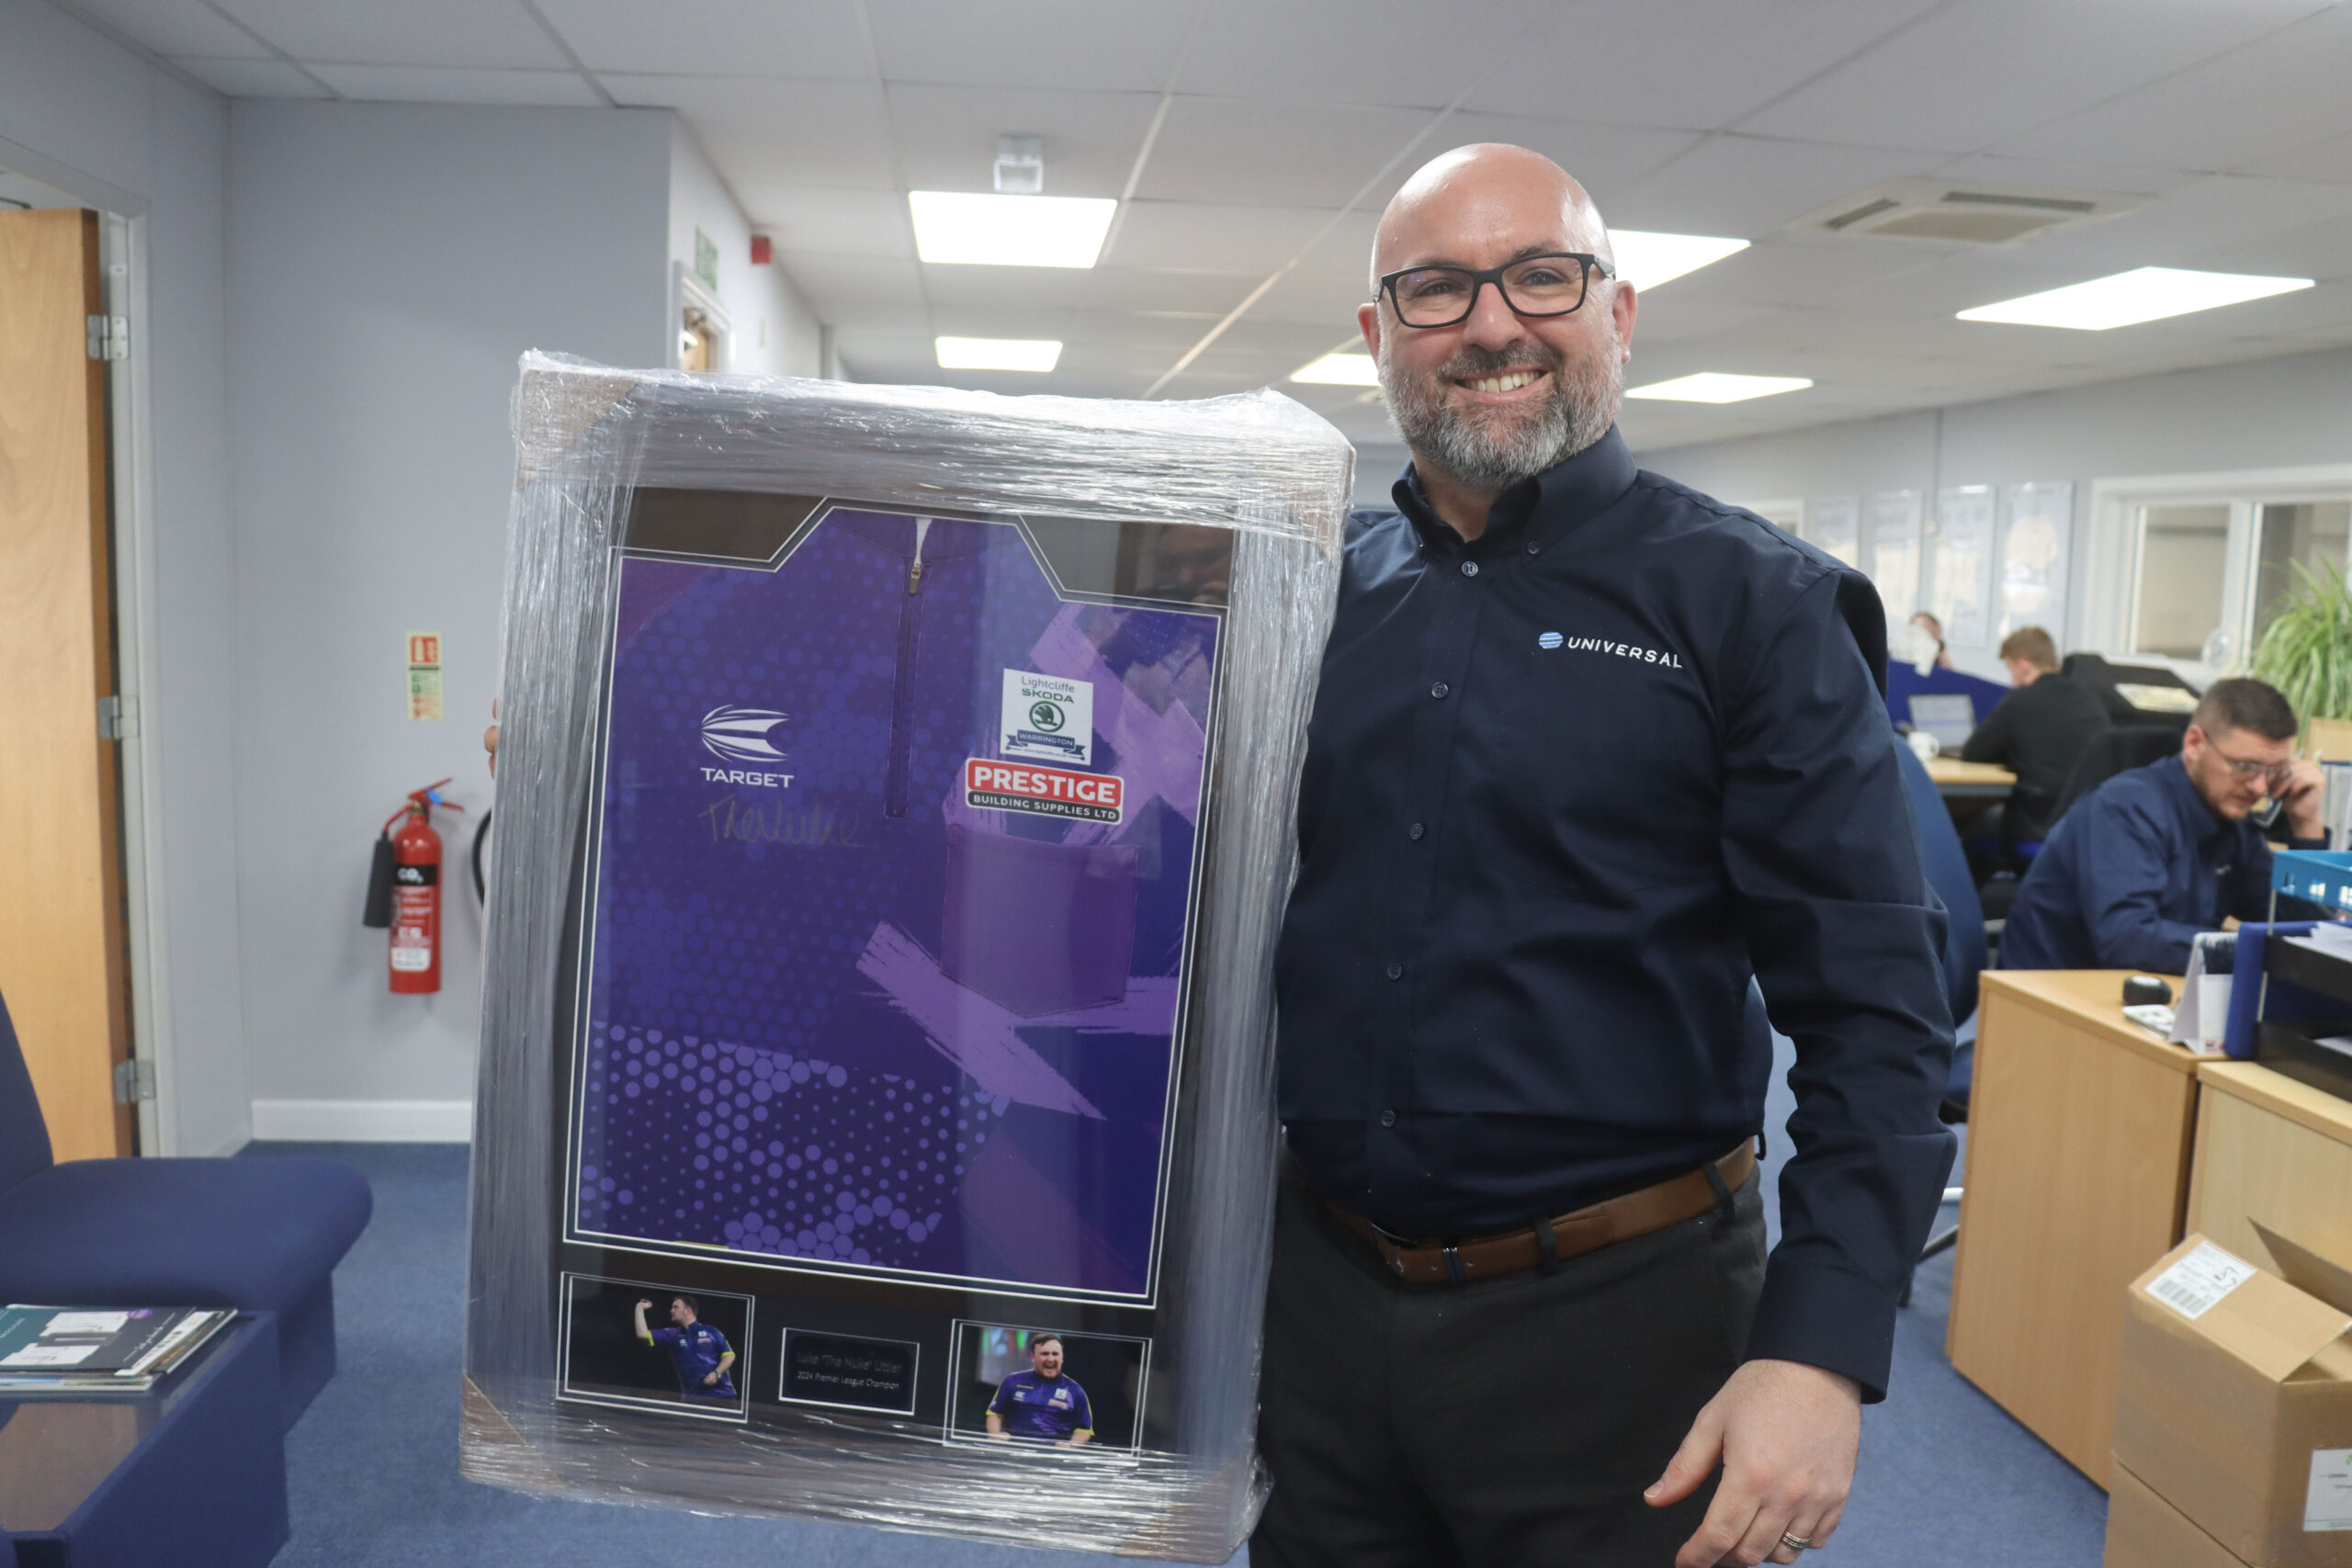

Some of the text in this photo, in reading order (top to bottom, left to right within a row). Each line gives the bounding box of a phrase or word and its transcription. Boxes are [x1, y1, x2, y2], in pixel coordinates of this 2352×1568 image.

[1567, 636, 1683, 669] UNIVERSAL
[1021, 675, 1075, 694] Lightcliffe
[1018, 732, 1074, 747] WARRINGTON
[700, 767, 795, 789] TARGET
[974, 766, 1116, 804] PRESTIGE
[973, 795, 1116, 820] BUILDING SUPPLIES LTD
